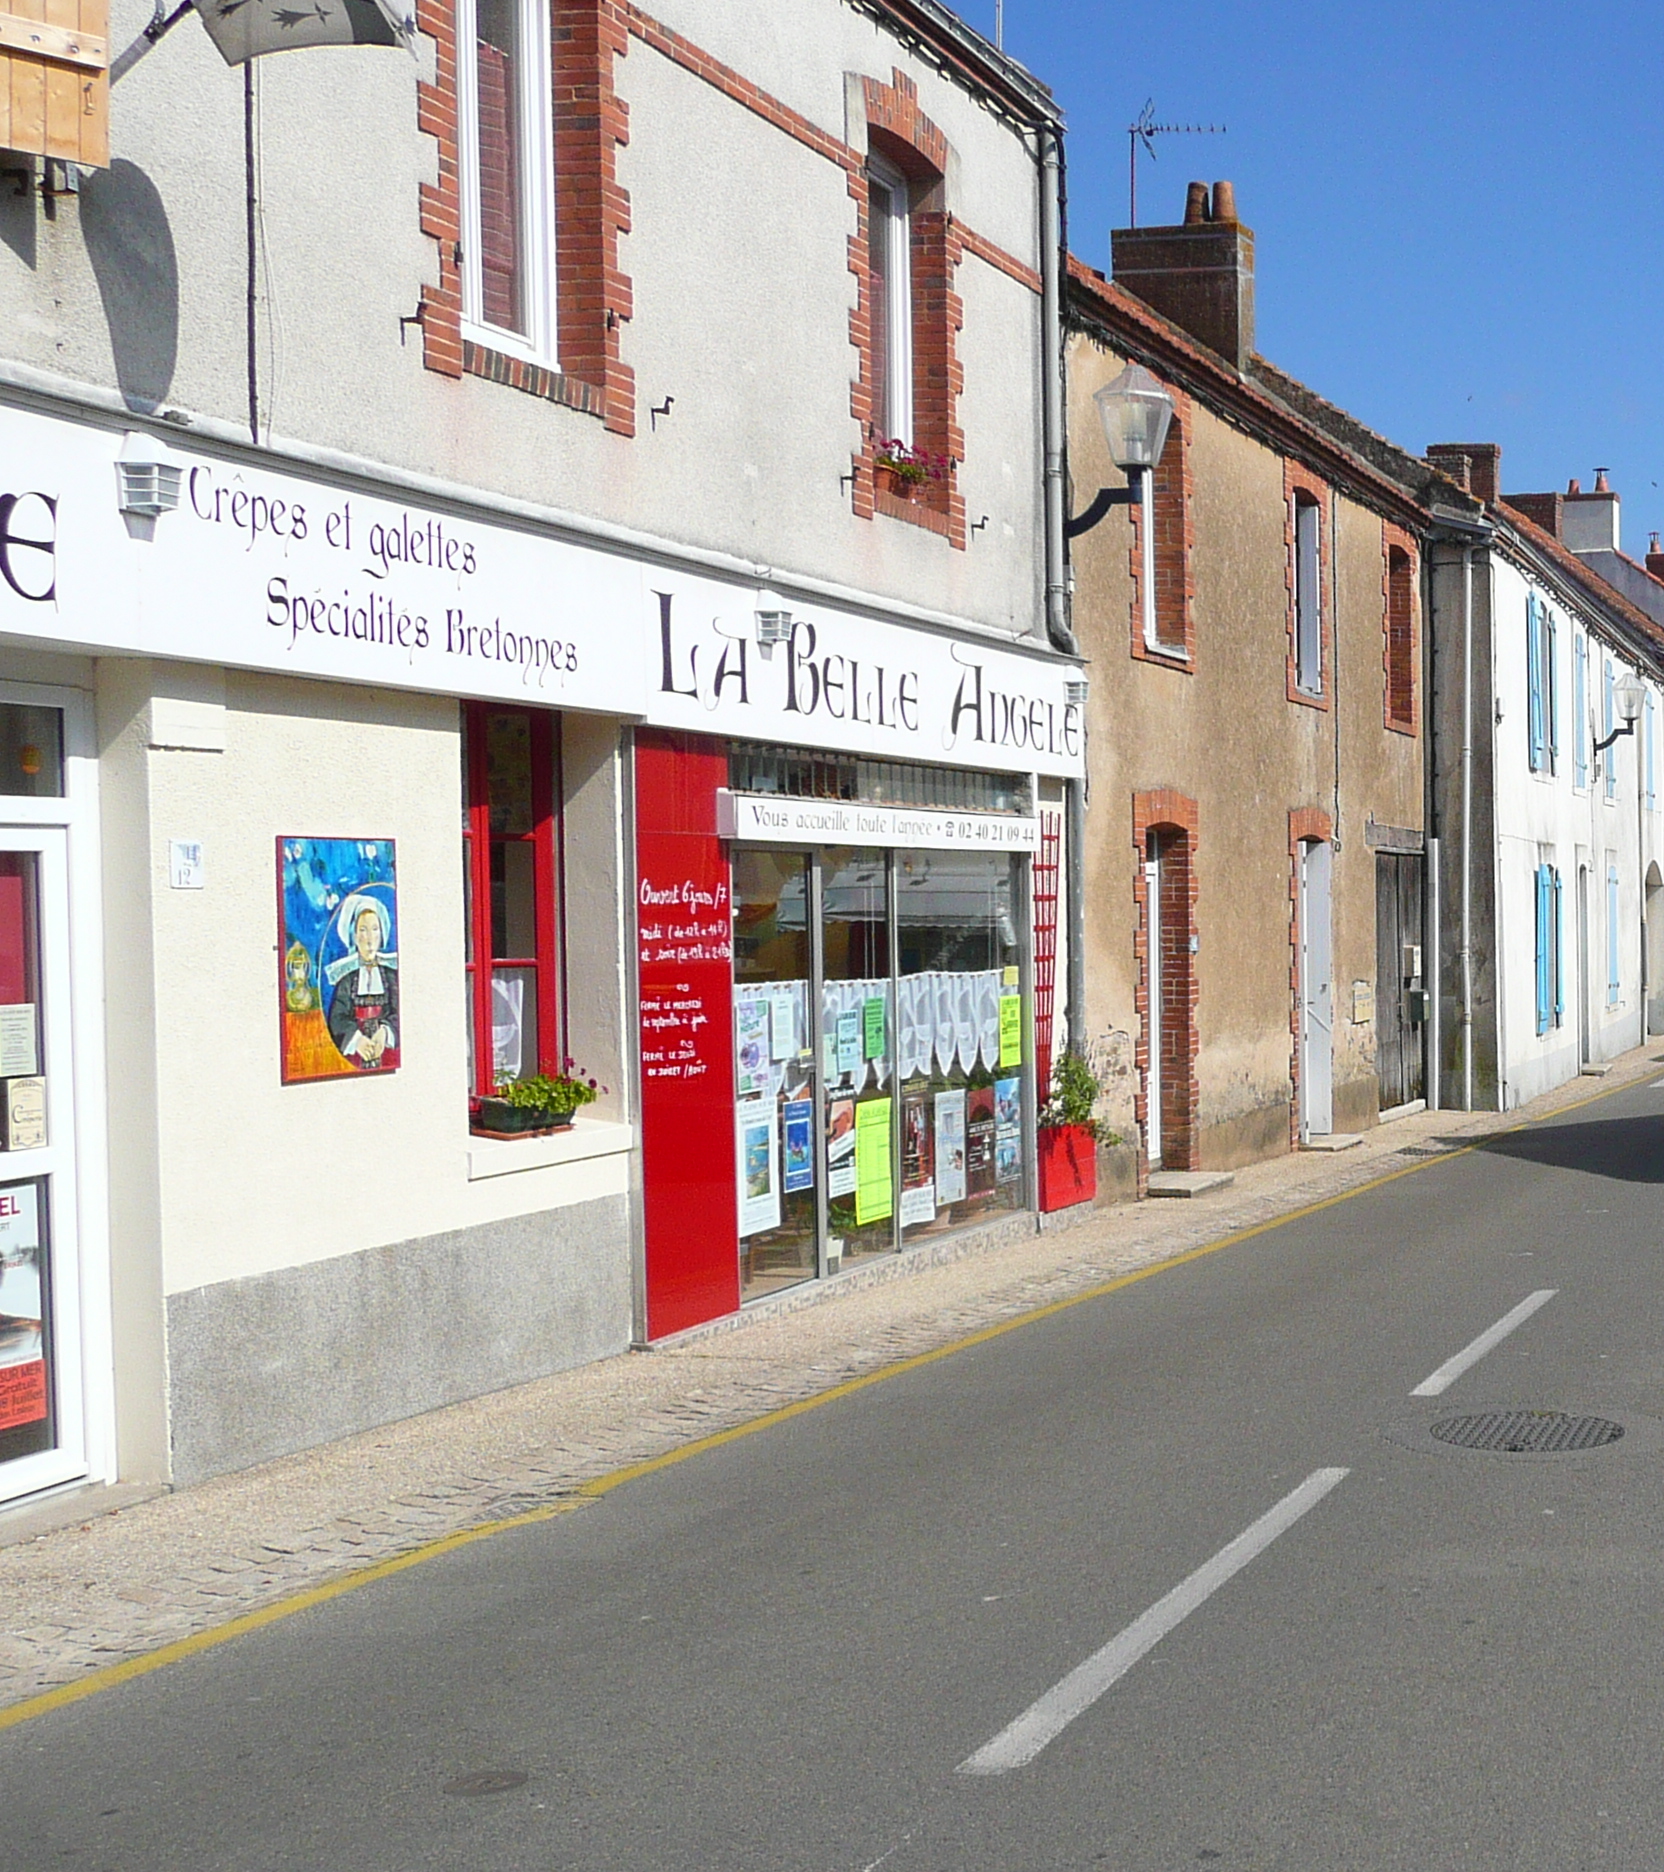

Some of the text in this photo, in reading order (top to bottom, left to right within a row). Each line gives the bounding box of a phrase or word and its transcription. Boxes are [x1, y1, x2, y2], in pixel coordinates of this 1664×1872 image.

[189, 465, 477, 592] Crêpes et galettes
[266, 576, 578, 688] Spécialités Bretonnes
[751, 805, 790, 828] Vous
[795, 809, 850, 832] accueille
[856, 812, 888, 834] toute
[957, 820, 973, 839] 02
[975, 822, 989, 840] 40
[991, 823, 1004, 841] 21
[1006, 825, 1020, 843] 09
[1022, 826, 1035, 844] 44
[178, 868, 192, 886] 12
[640, 878, 680, 905] Ouvert
